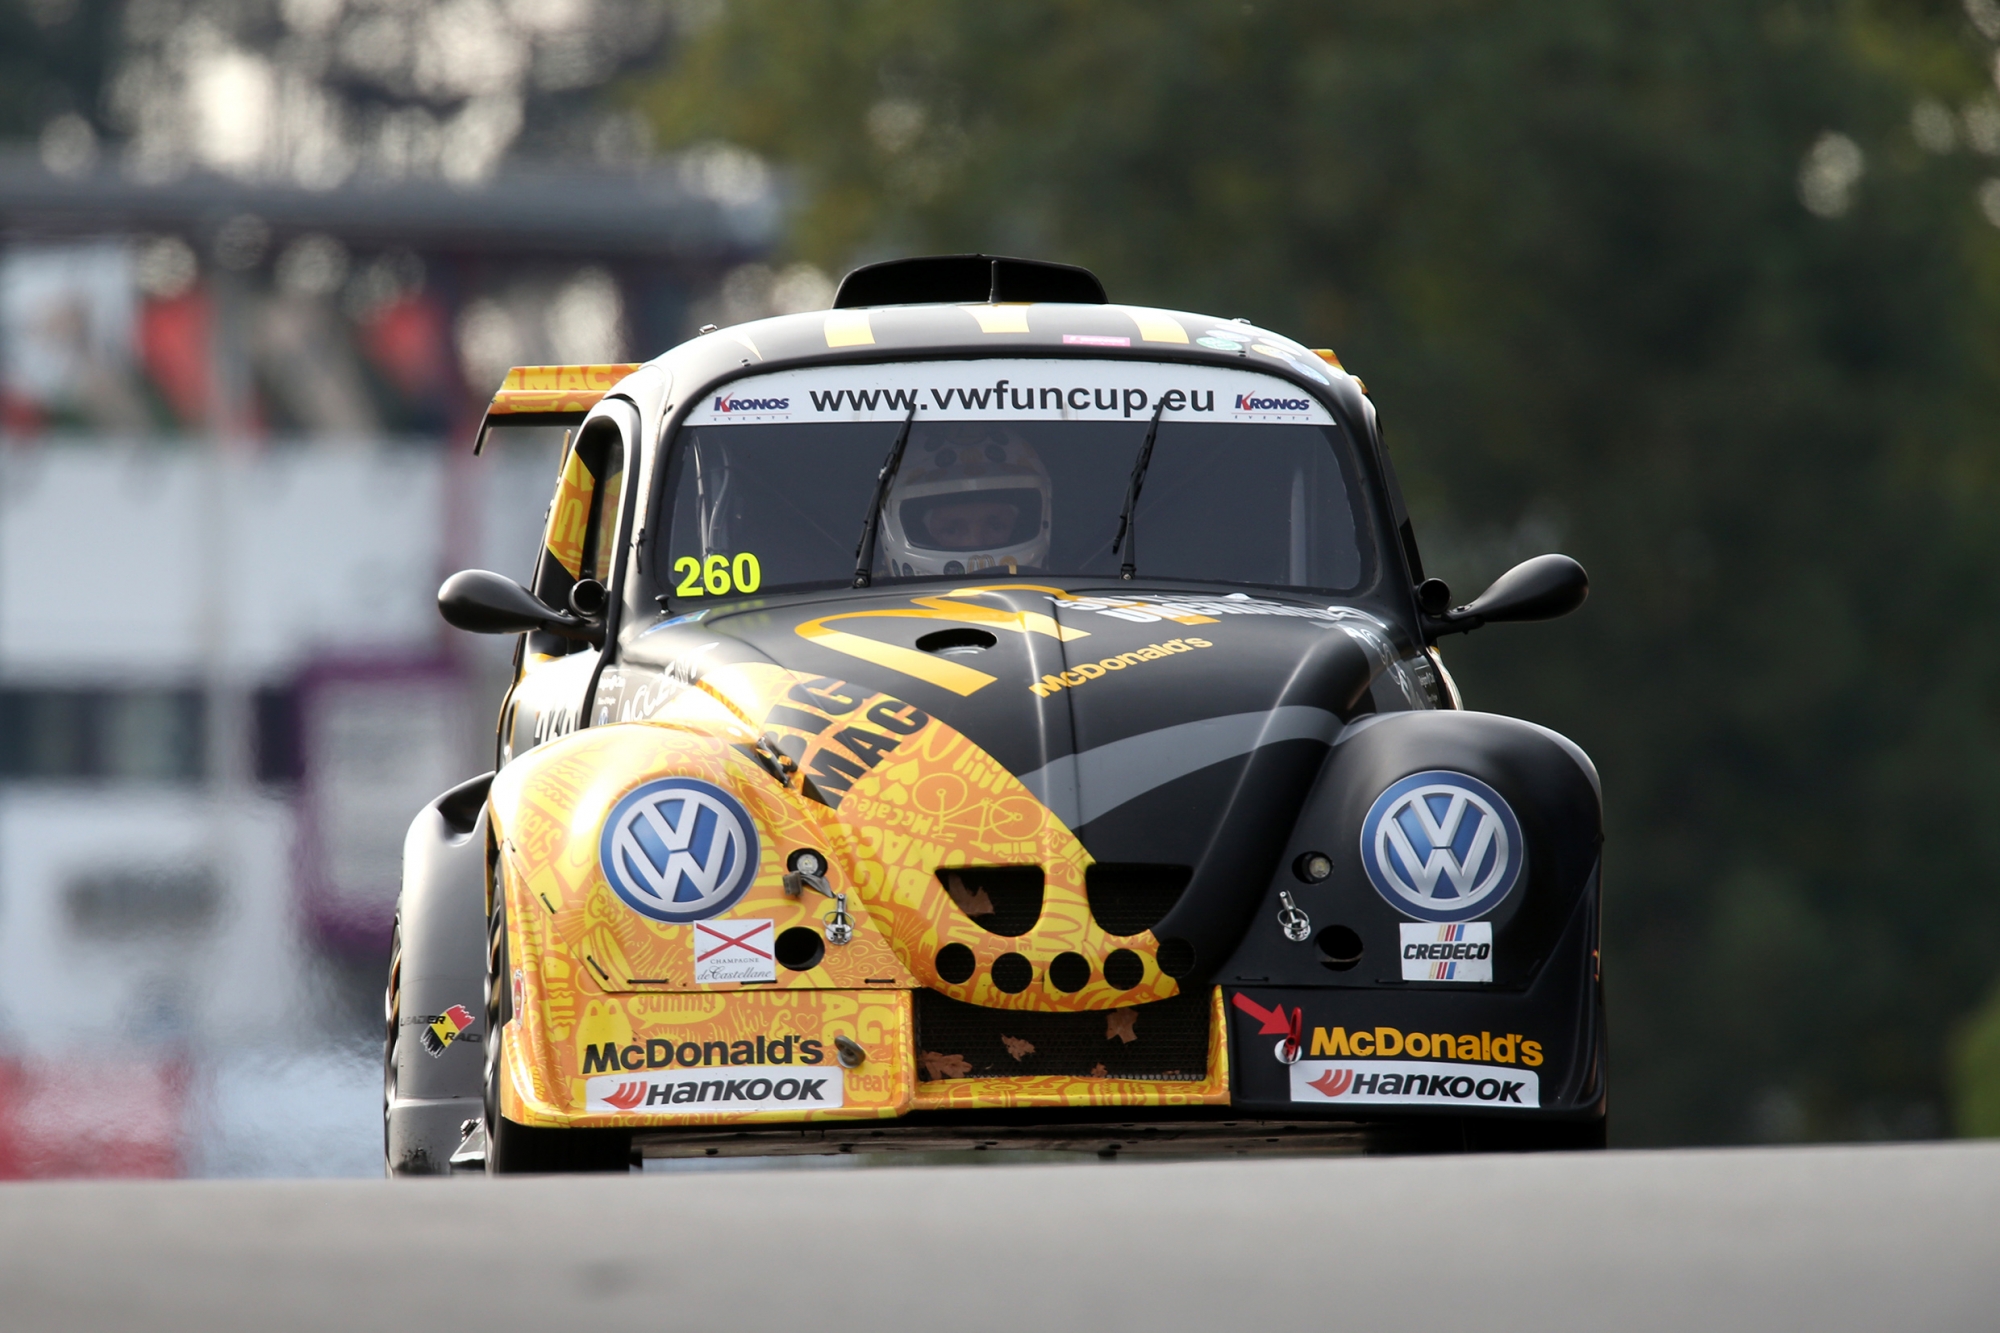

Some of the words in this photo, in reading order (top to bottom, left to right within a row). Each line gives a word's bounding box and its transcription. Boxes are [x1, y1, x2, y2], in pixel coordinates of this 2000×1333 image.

[714, 391, 790, 412] KRONOS
[809, 379, 1214, 418] www.vwfuncup.eu
[1235, 389, 1310, 411] KRONOS
[673, 552, 761, 598] 260
[1028, 636, 1214, 698] McDonald's
[801, 699, 930, 811] MAC
[710, 957, 760, 965] CHAMPAGNE
[1403, 942, 1490, 961] CREDECO
[400, 1015, 447, 1027] LEADER
[582, 1035, 824, 1075] McDonald's
[1310, 1025, 1544, 1067] McDonald's
[847, 1069, 890, 1093] treat
